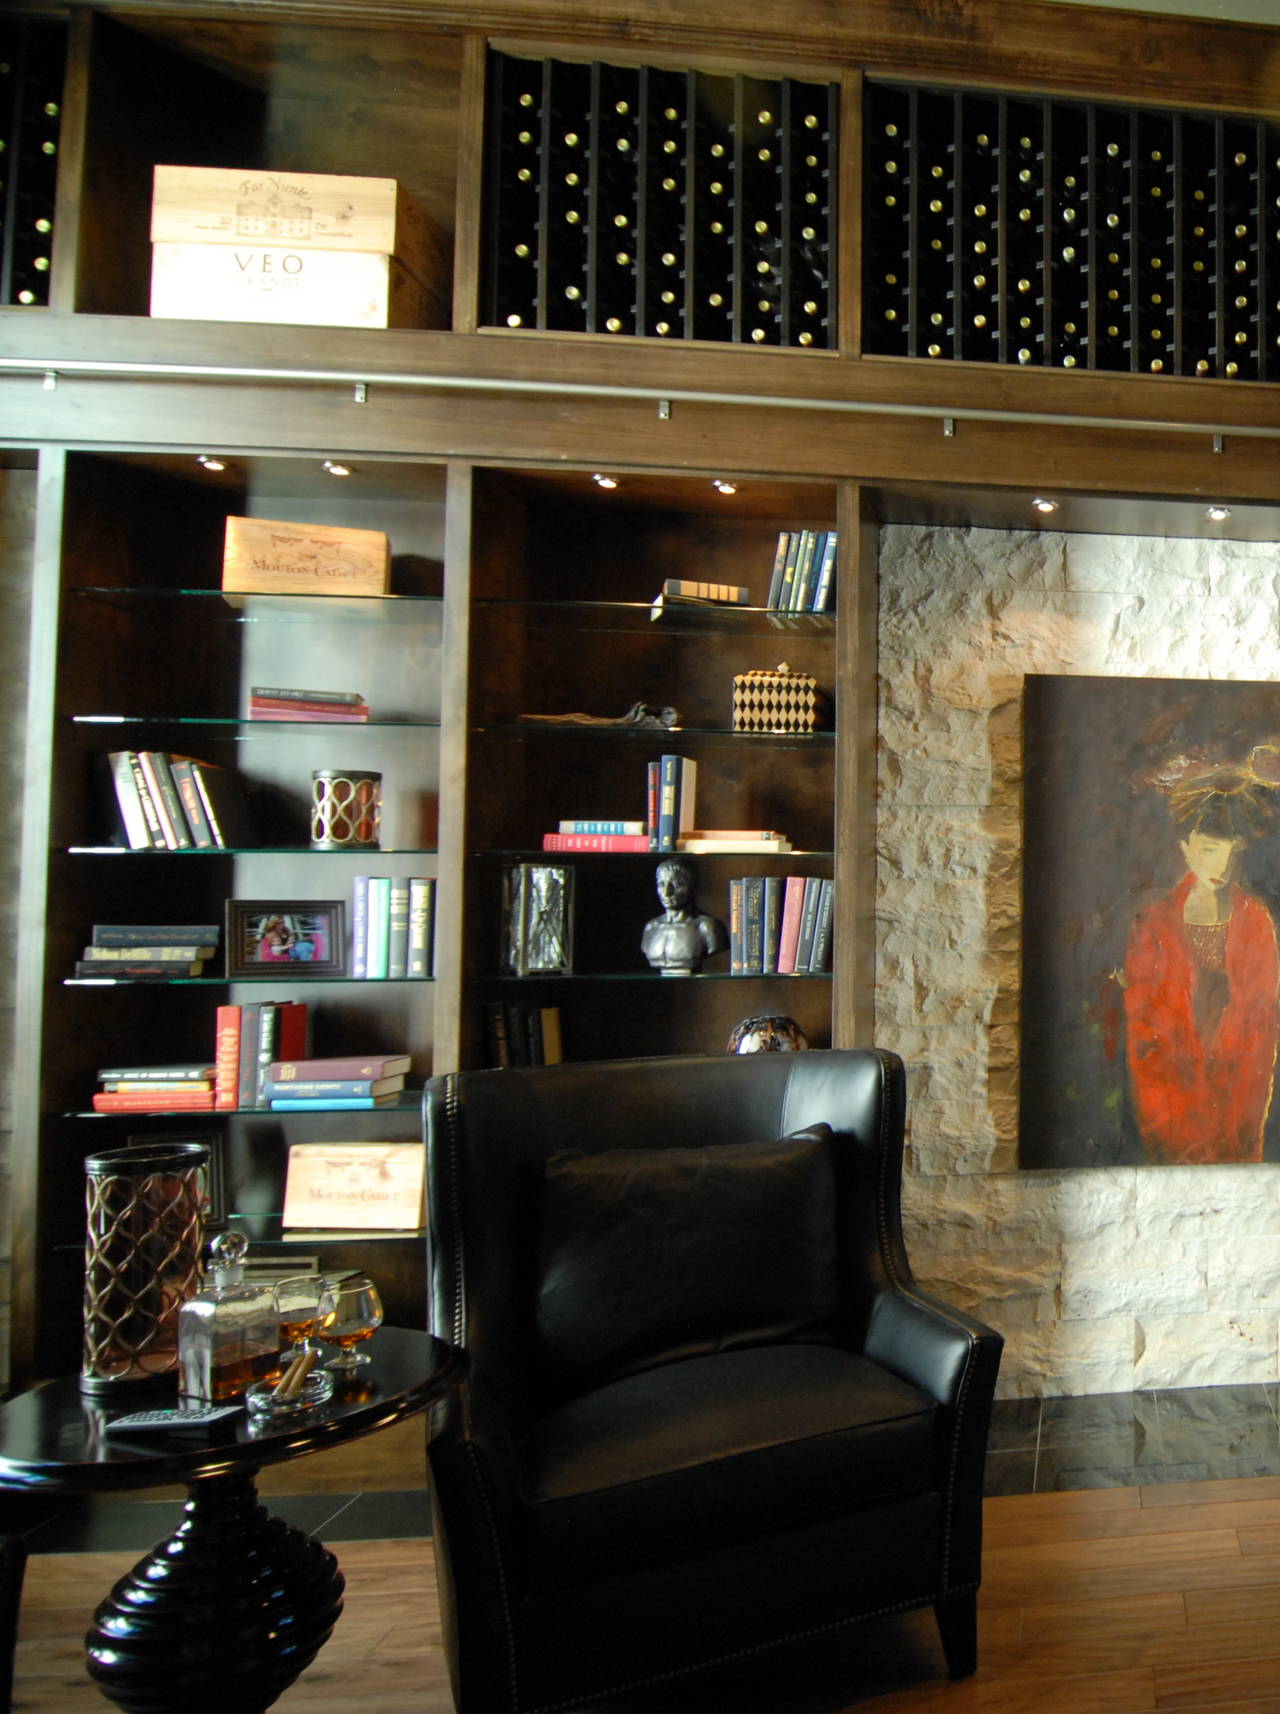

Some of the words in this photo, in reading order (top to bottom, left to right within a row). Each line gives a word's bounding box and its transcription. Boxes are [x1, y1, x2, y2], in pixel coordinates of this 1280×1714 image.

[240, 179, 263, 196] Far
[267, 177, 312, 200] Niente
[233, 253, 303, 274] VEO
